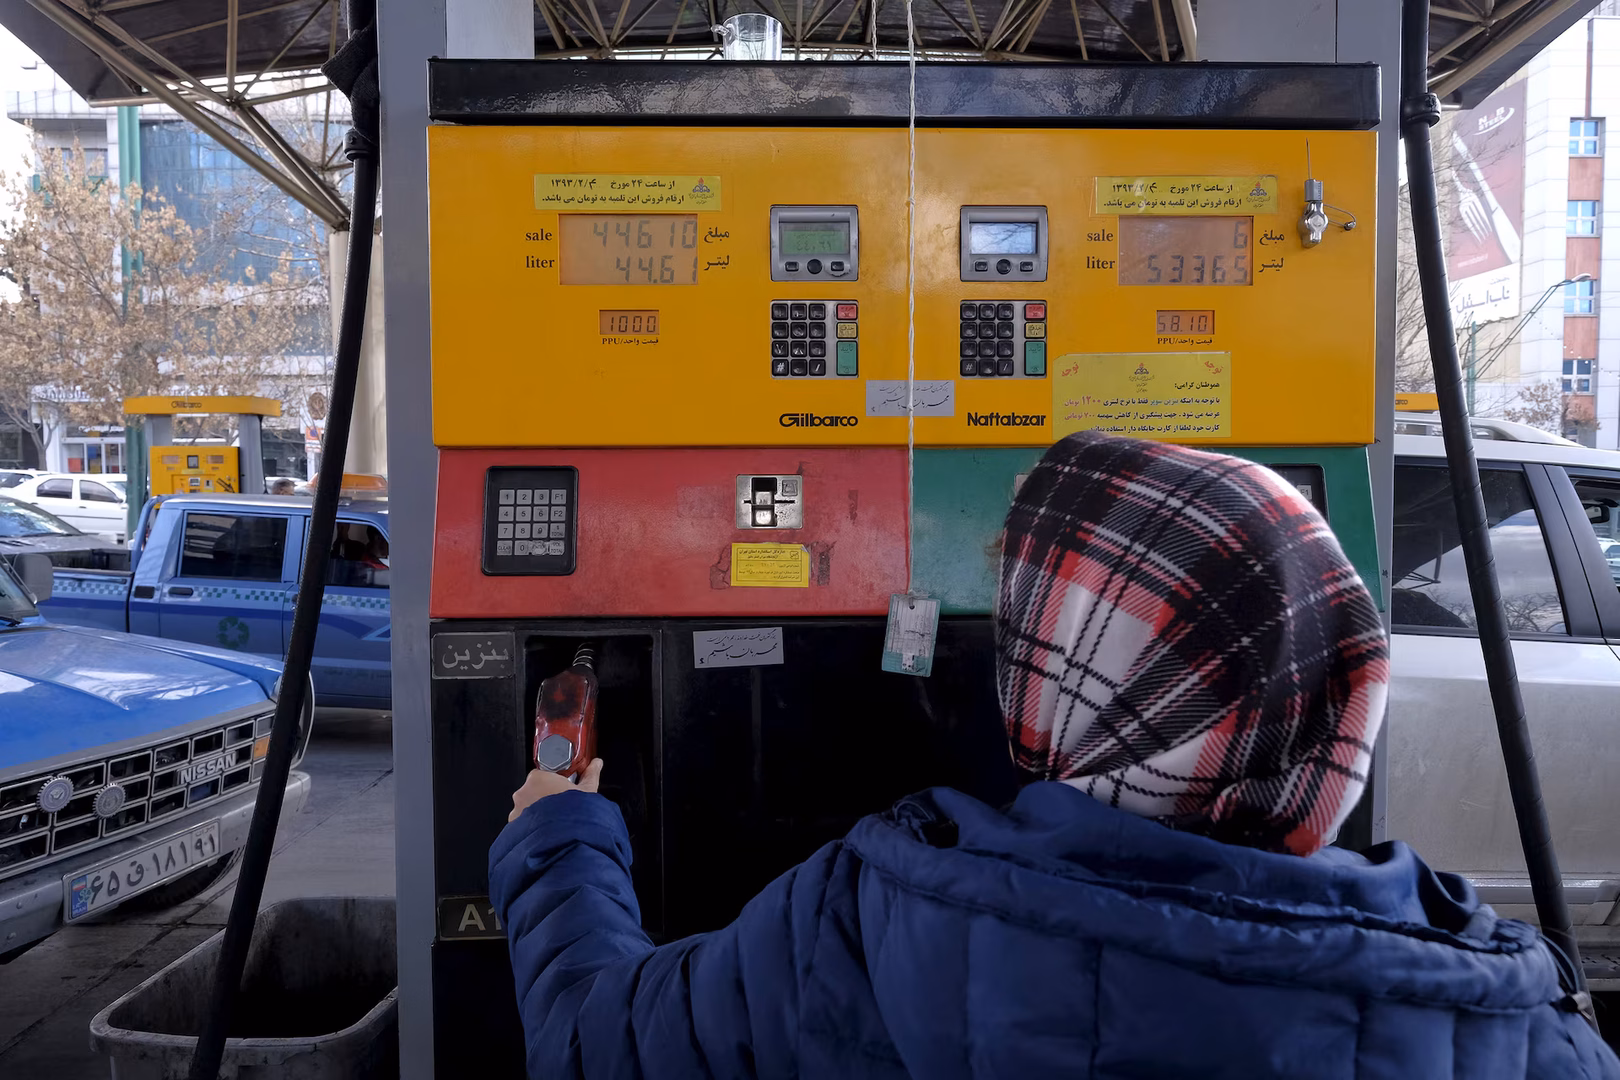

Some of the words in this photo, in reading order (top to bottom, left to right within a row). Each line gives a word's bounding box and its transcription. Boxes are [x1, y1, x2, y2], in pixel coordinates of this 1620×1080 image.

[1478, 107, 1505, 125] NAB
[610, 181, 630, 189] مورخ
[645, 180, 666, 188] ساعت
[668, 180, 675, 188] از
[1170, 185, 1190, 193] مورخ
[1203, 184, 1224, 192] ساعت
[1226, 184, 1232, 192] از
[564, 195, 575, 204] می
[577, 194, 598, 204] تومان
[608, 194, 625, 202] تلمبه
[627, 194, 640, 204] این
[642, 196, 664, 204] فروش
[666, 195, 684, 204] ارقام
[1124, 199, 1136, 208] می
[1137, 199, 1158, 208] تومان
[1159, 200, 1166, 208] به
[1186, 199, 1198, 208] این
[1200, 200, 1222, 208] فروش
[1223, 199, 1242, 208] ارقام
[525, 229, 552, 242] sale
[593, 220, 698, 249] 44610
[704, 226, 730, 243] مبلغ
[1086, 229, 1114, 242] sale
[1234, 220, 1248, 250] 6
[1259, 229, 1285, 246] مبلغ
[525, 256, 556, 268] liter
[704, 255, 730, 271] لیتر
[1086, 256, 1116, 270] liter
[1258, 257, 1284, 272] لیتر
[616, 255, 698, 284] 44.61
[1147, 254, 1248, 284] 53365
[610, 316, 657, 332] 1000
[1158, 315, 1208, 332] 58.10
[1061, 362, 1080, 377] توجه
[1204, 361, 1224, 374] توجه
[1195, 381, 1220, 390] هموطنان
[1064, 399, 1080, 407] تومان
[1120, 398, 1130, 406] نرخ
[1200, 398, 1215, 406] توجه
[1114, 412, 1130, 420] کاهش
[1132, 412, 1138, 420] از
[1207, 410, 1220, 418] عرضه
[779, 412, 858, 428] Gilbarco
[966, 412, 1046, 427] Naftabzar
[1178, 424, 1191, 432] لطفا
[1206, 424, 1220, 432] کارت
[442, 640, 509, 670] بنزین
[707, 643, 734, 664] باشیم
[730, 642, 778, 658] مهربان
[179, 750, 236, 785] NISSAN
[90, 870, 120, 904] ۶۵
[127, 860, 144, 887] ق
[152, 841, 188, 876] ۱۸۱
[194, 833, 216, 858] ۹۱
[72, 906, 88, 917] IRAN
[458, 904, 502, 932] A1
